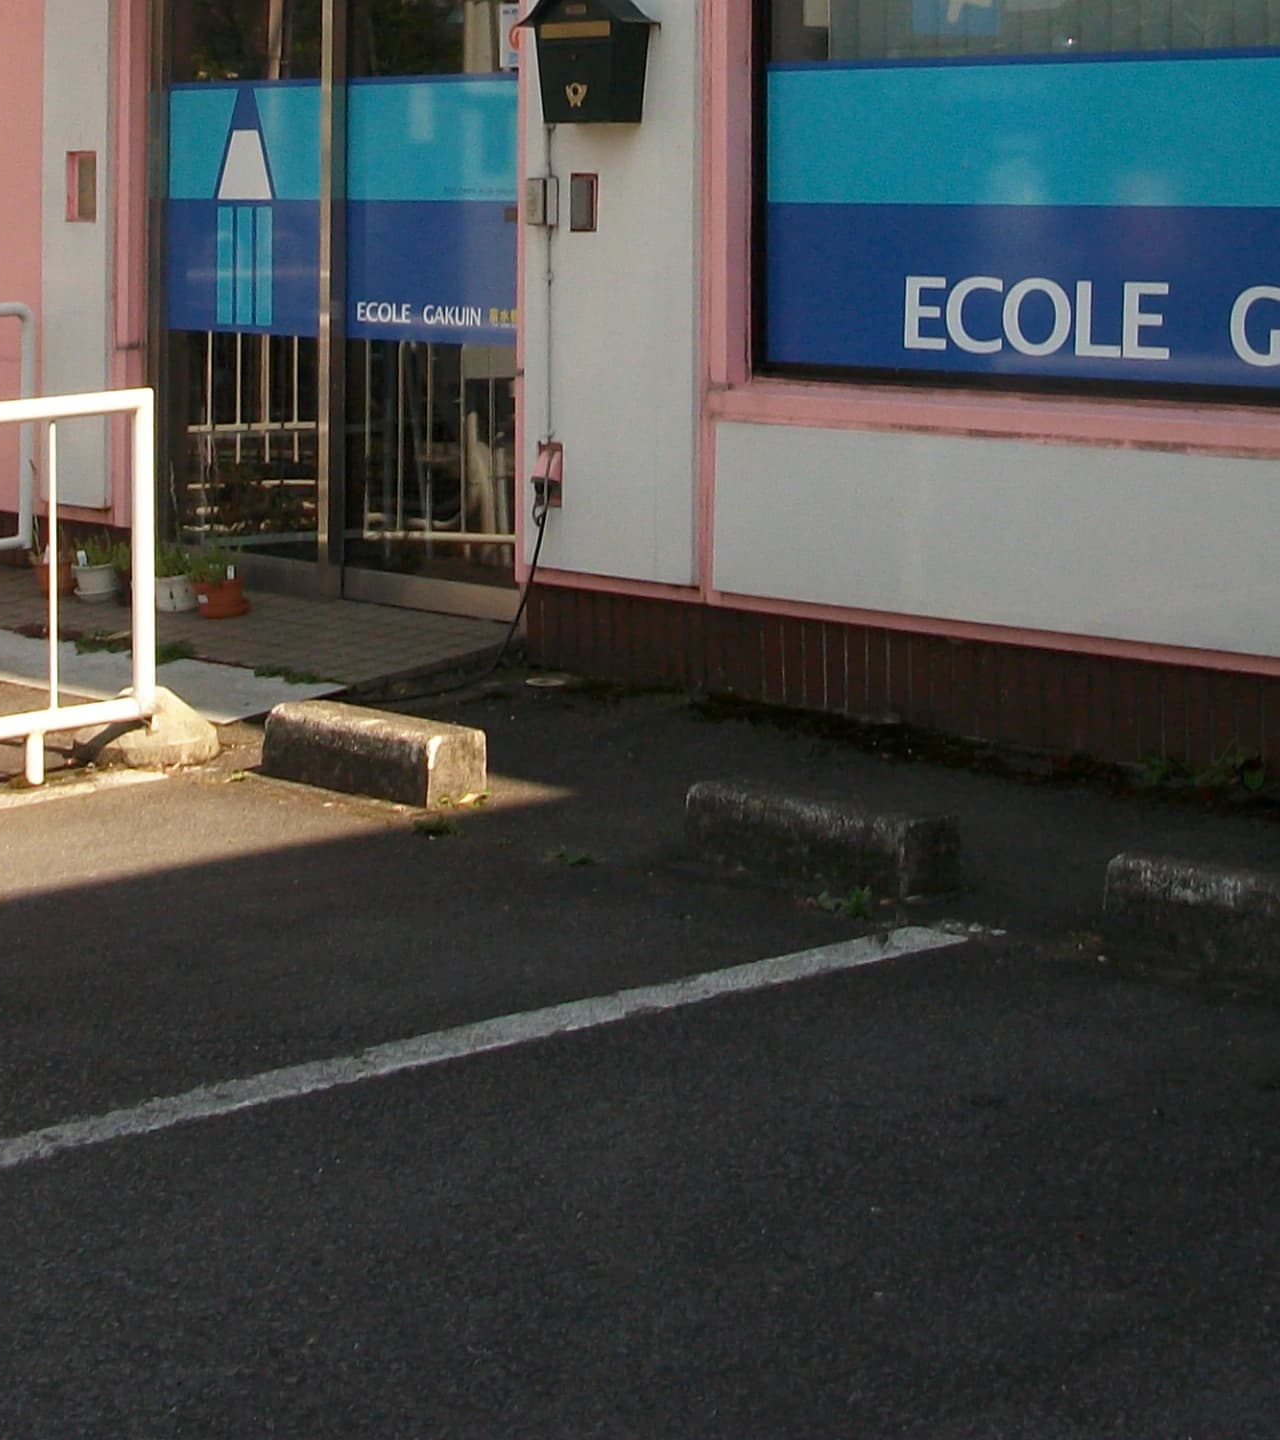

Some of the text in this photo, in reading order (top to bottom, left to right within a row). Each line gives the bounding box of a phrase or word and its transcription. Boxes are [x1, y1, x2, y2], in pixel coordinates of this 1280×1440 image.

[356, 301, 412, 324] ECOLE
[422, 304, 482, 327] GAKUIN
[902, 274, 1171, 361] ECOLE
